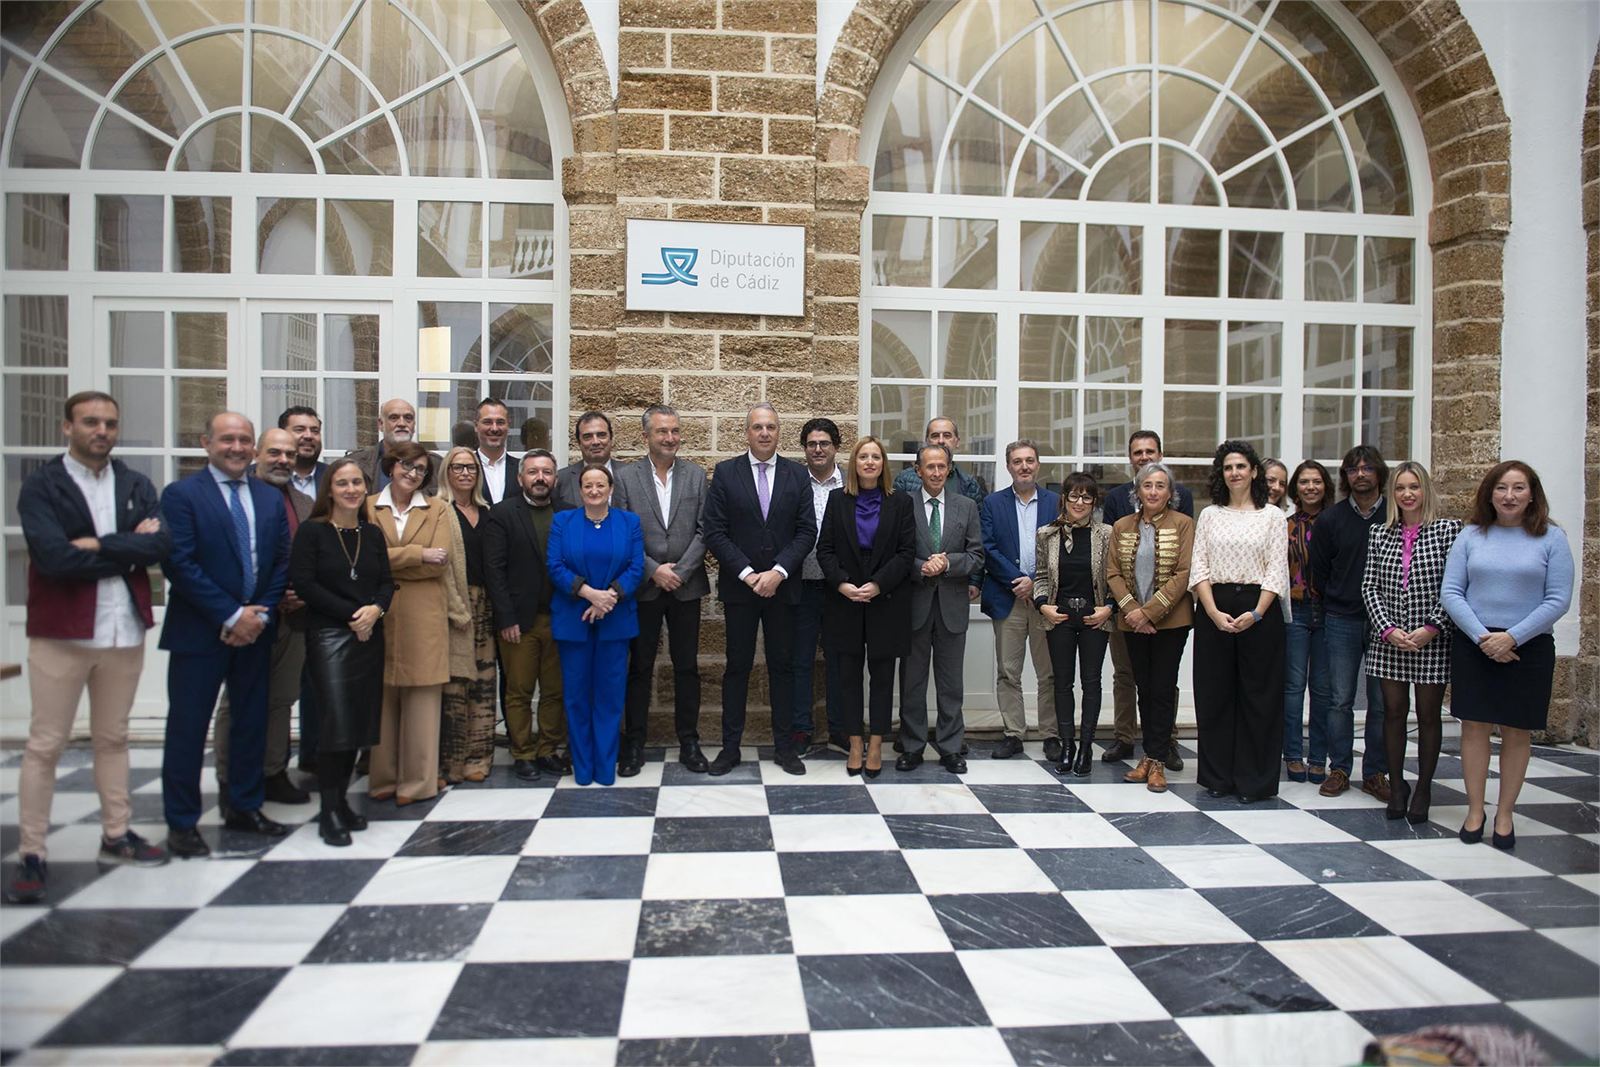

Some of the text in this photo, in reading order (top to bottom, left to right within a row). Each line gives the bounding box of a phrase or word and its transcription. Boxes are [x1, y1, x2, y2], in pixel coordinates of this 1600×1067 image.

[710, 249, 795, 268] Diputación
[710, 273, 780, 290] de Cádiz
